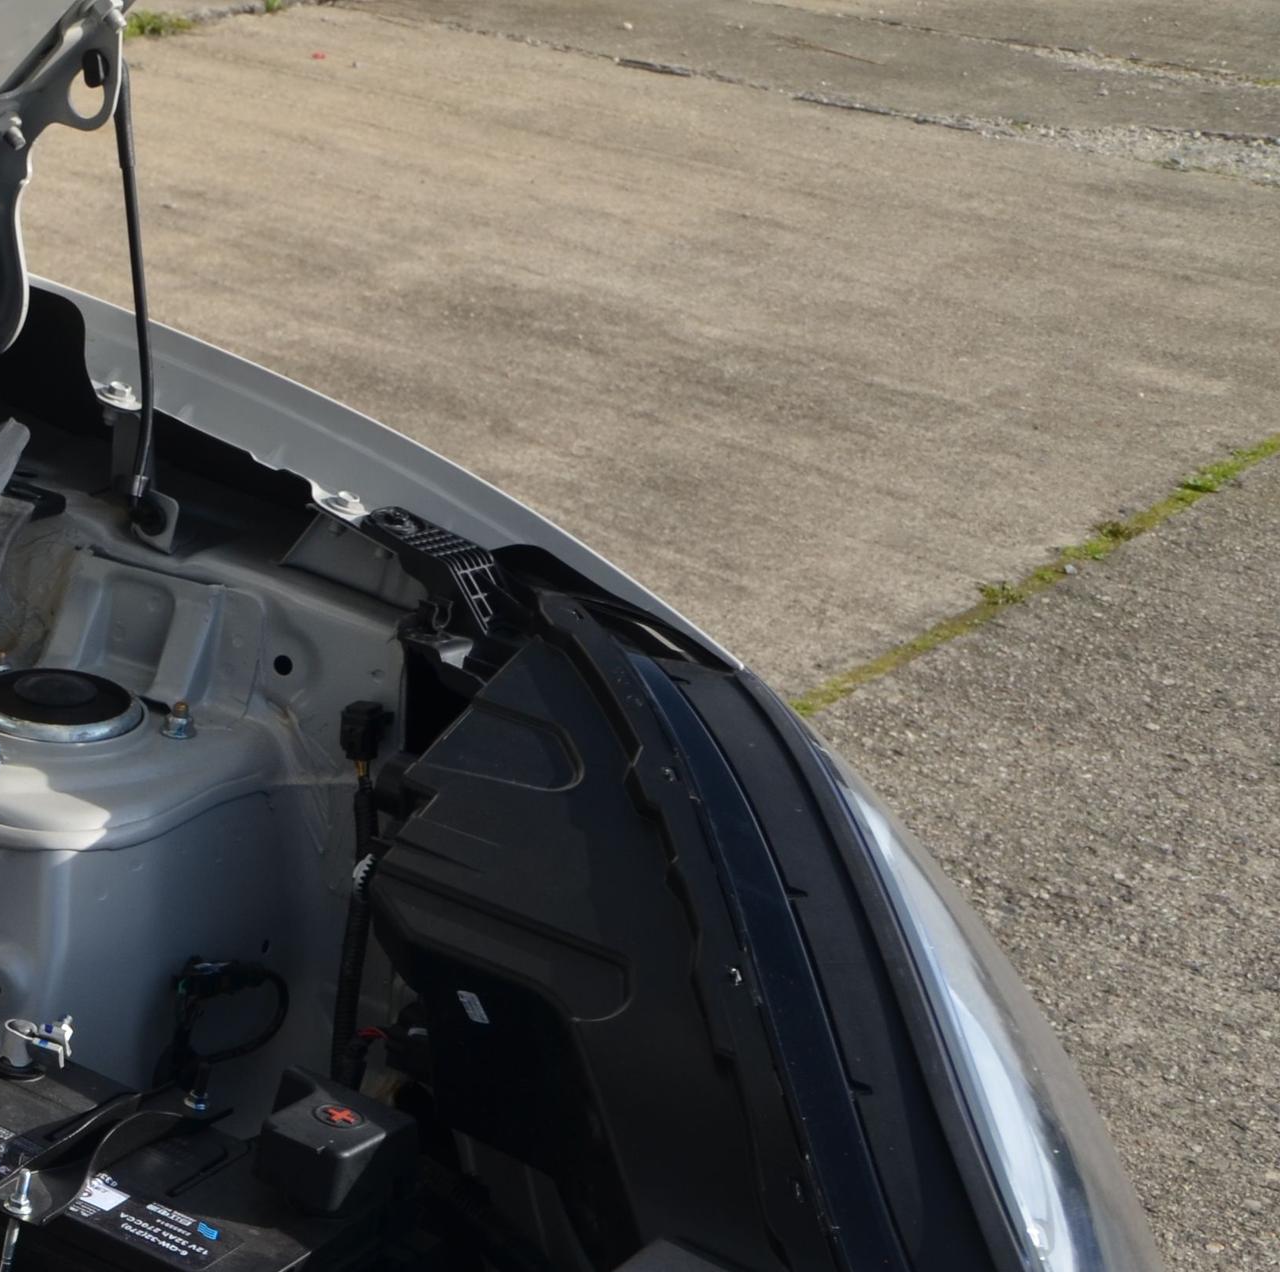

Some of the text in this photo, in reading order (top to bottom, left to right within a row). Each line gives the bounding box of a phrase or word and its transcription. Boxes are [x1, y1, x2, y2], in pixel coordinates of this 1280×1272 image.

[116, 1211, 163, 1234] 270CCA
[158, 1229, 191, 1246] 32Ah
[186, 1242, 211, 1256] 12V
